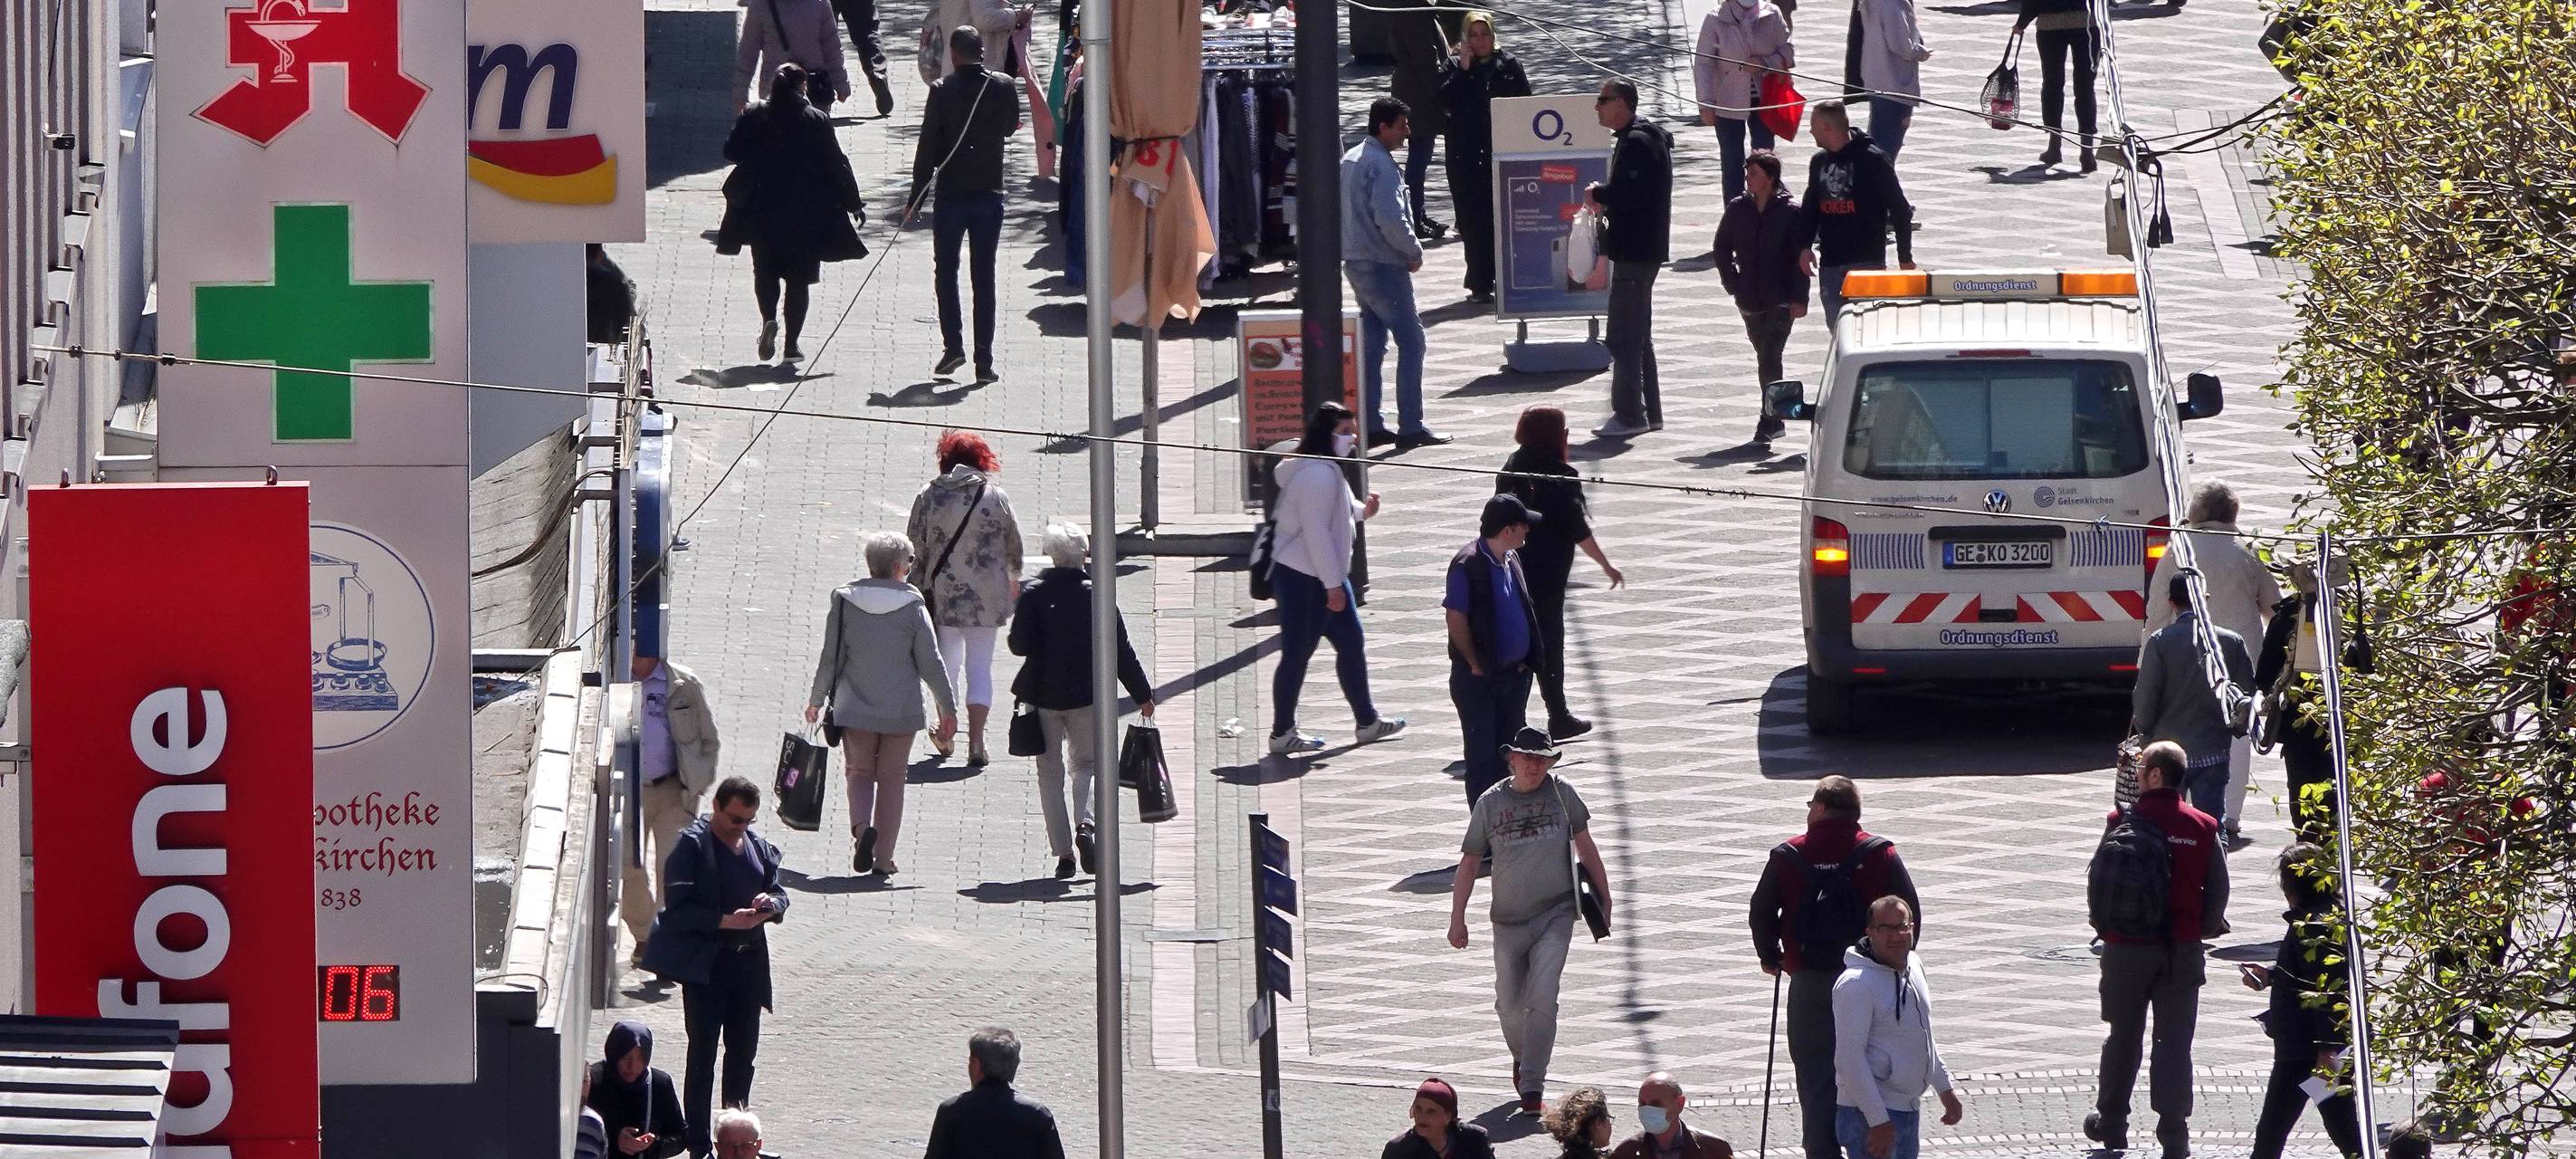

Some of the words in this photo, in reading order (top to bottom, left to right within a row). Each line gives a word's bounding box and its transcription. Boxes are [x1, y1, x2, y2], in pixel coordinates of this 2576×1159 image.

[1532, 109, 1573, 146] O2
[1953, 279, 2037, 293] Ordnungsdienst
[2057, 487, 2078, 495] Stadt
[2058, 497, 2114, 505] Gelsenkirchen
[1955, 545, 1975, 561] GE
[2011, 544, 2049, 561] 3200
[1940, 628, 2059, 647] Ordnungsdienst
[324, 965, 395, 1020] 06
